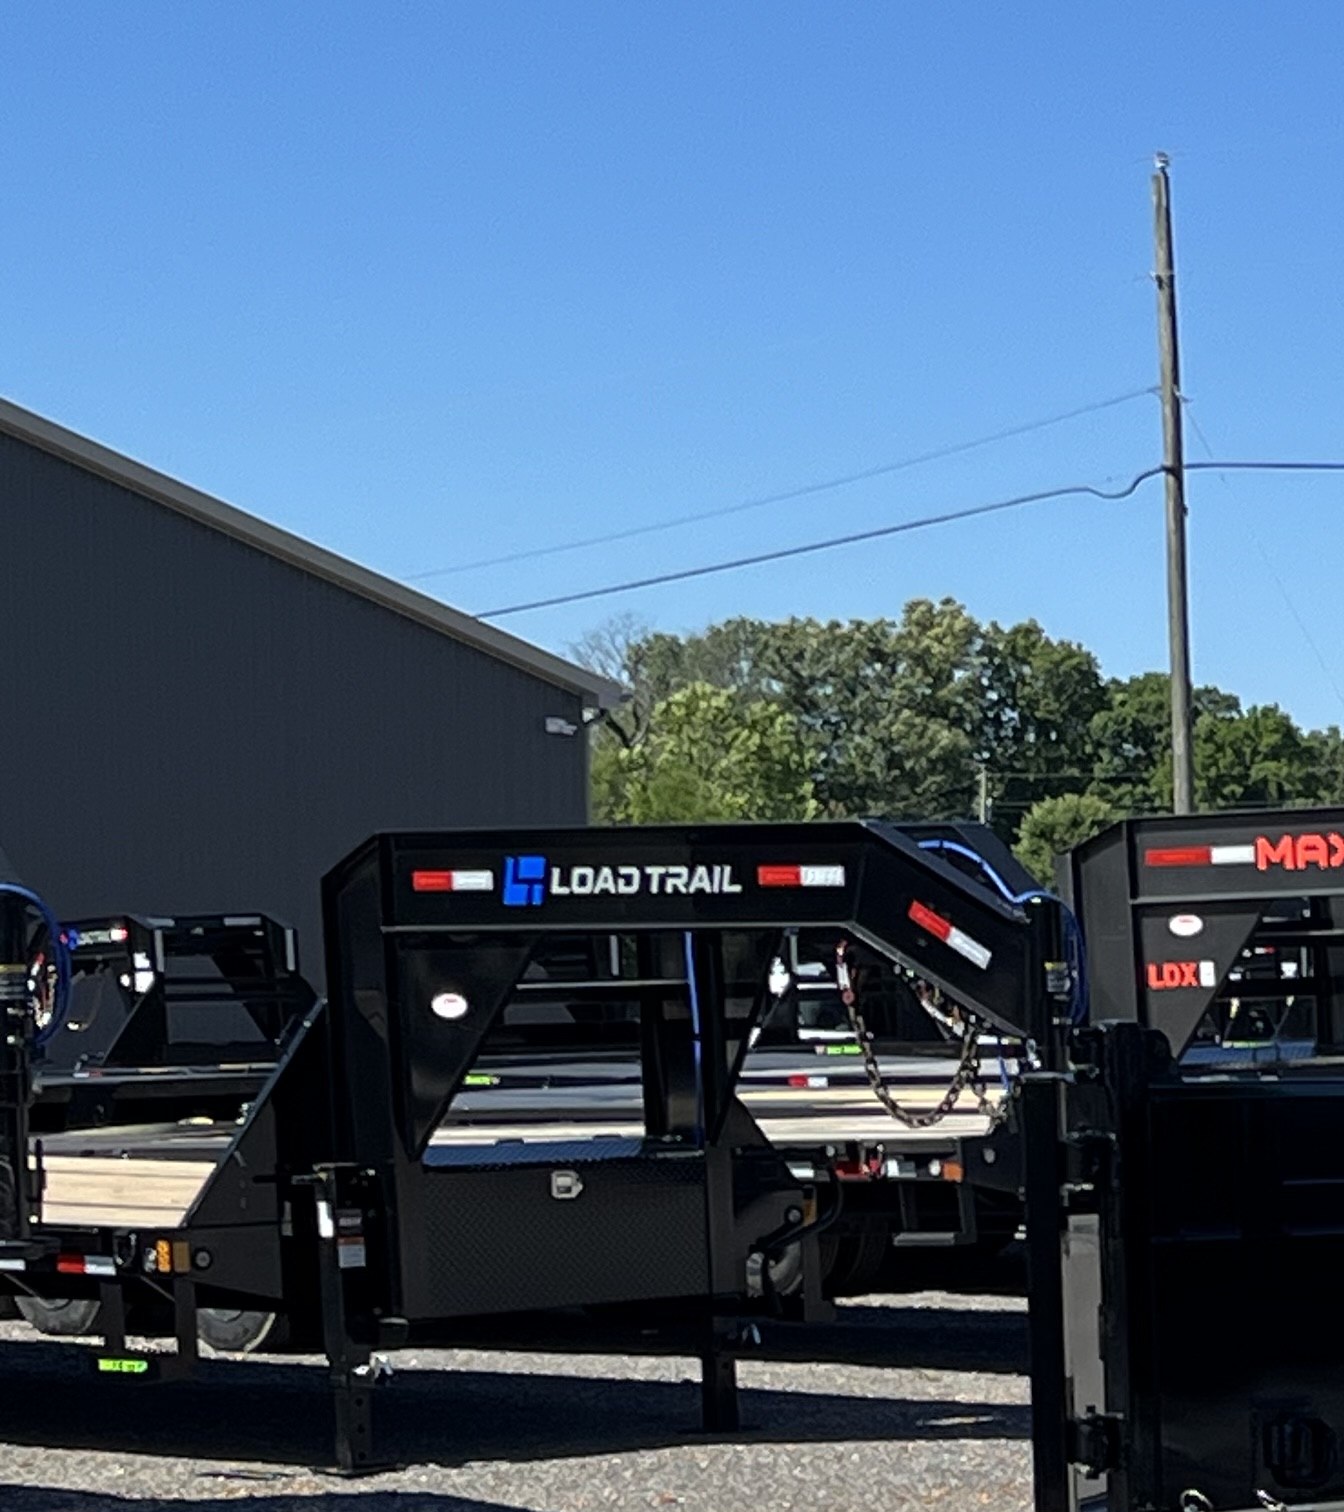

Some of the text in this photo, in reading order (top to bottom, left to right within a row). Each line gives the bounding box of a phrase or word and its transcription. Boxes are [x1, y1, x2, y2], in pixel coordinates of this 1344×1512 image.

[550, 864, 742, 895] LOAD TRAIL
[1147, 961, 1199, 990] LDX
